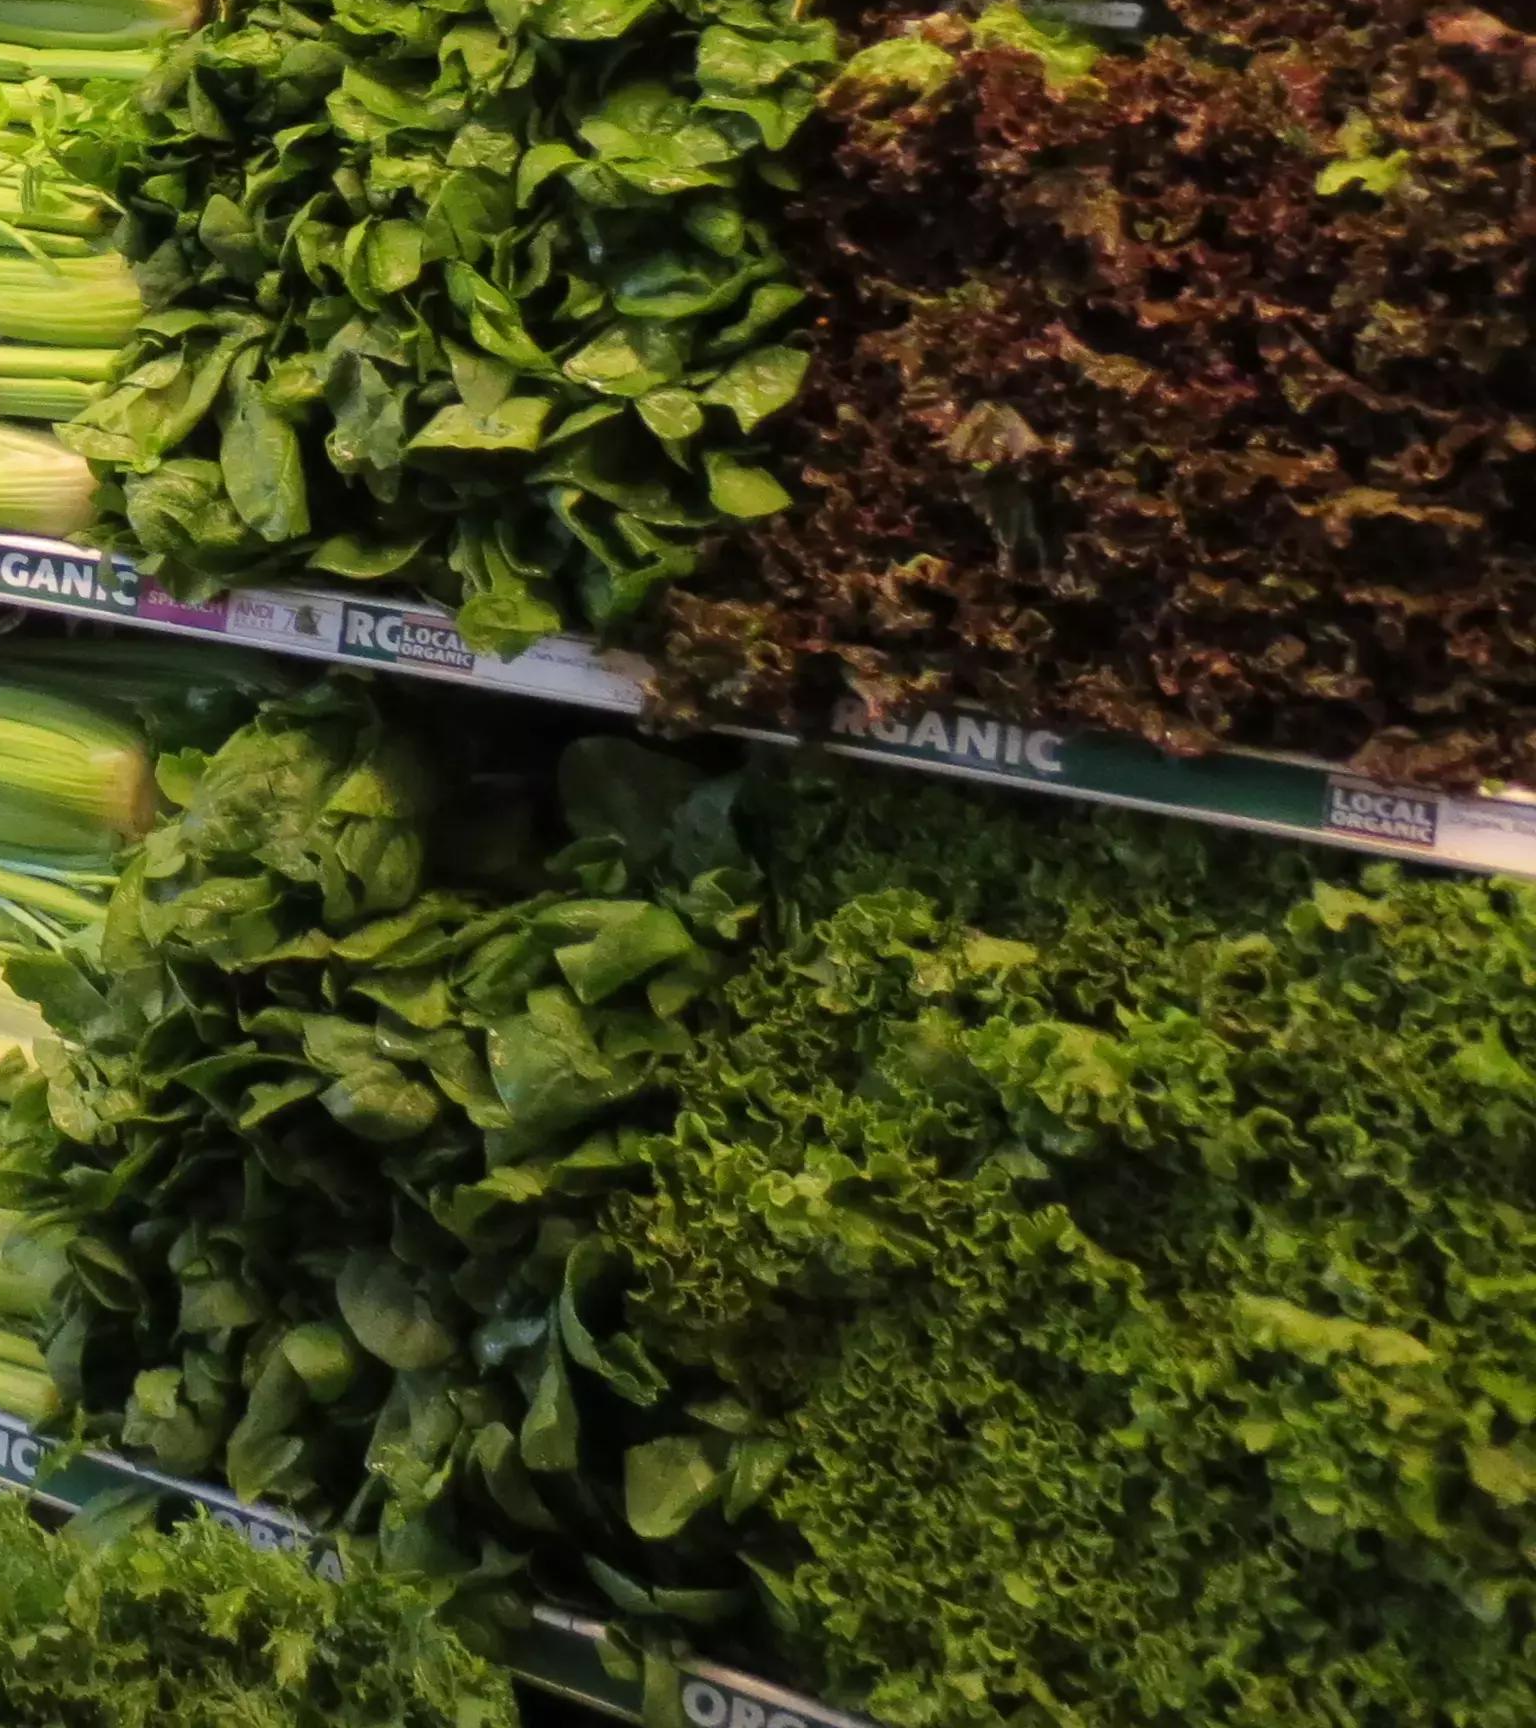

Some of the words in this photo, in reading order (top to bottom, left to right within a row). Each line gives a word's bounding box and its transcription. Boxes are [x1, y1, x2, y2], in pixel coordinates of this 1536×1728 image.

[235, 601, 275, 619] ANDI
[401, 641, 473, 668] ORGANIC
[831, 699, 1065, 774] RGANIC
[1332, 787, 1432, 825] LOCAL
[1330, 810, 1435, 842] ORGANIC
